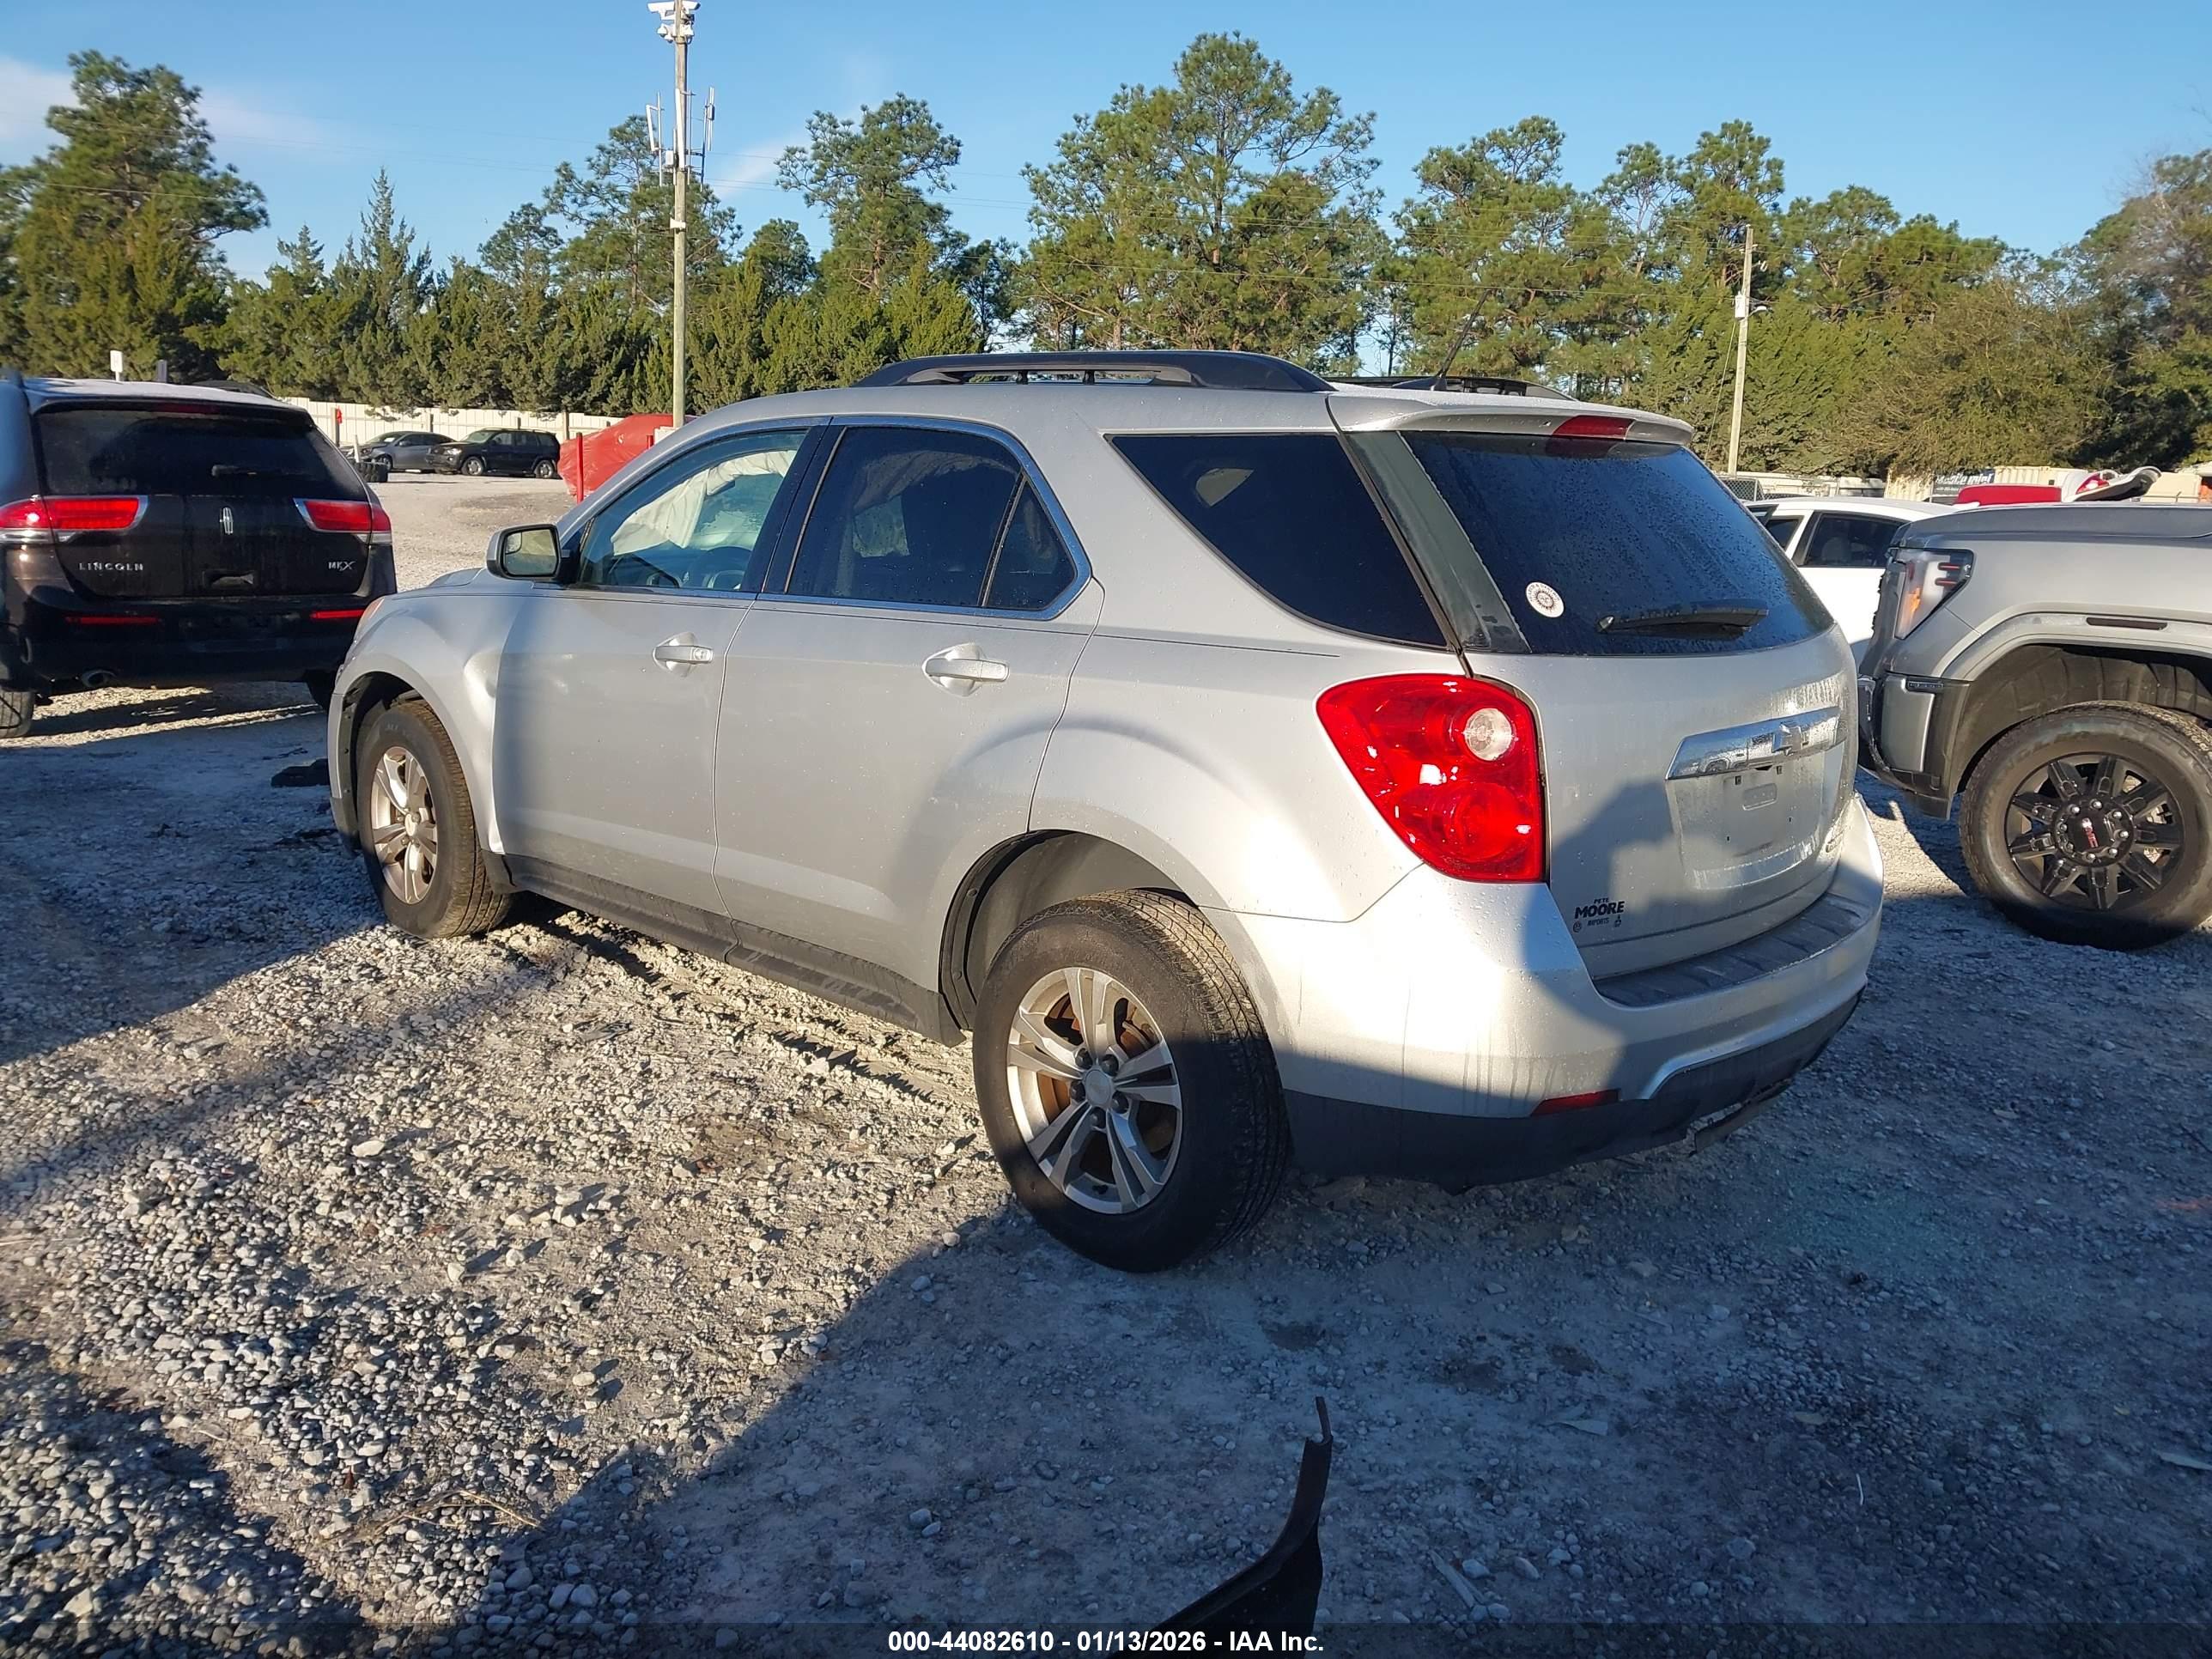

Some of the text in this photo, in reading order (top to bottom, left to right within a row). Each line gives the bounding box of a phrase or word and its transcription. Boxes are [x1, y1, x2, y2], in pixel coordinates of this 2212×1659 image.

[79, 562, 143, 571] LINCOLN
[328, 561, 356, 571] MKX
[1575, 901, 1625, 919] MOORE
